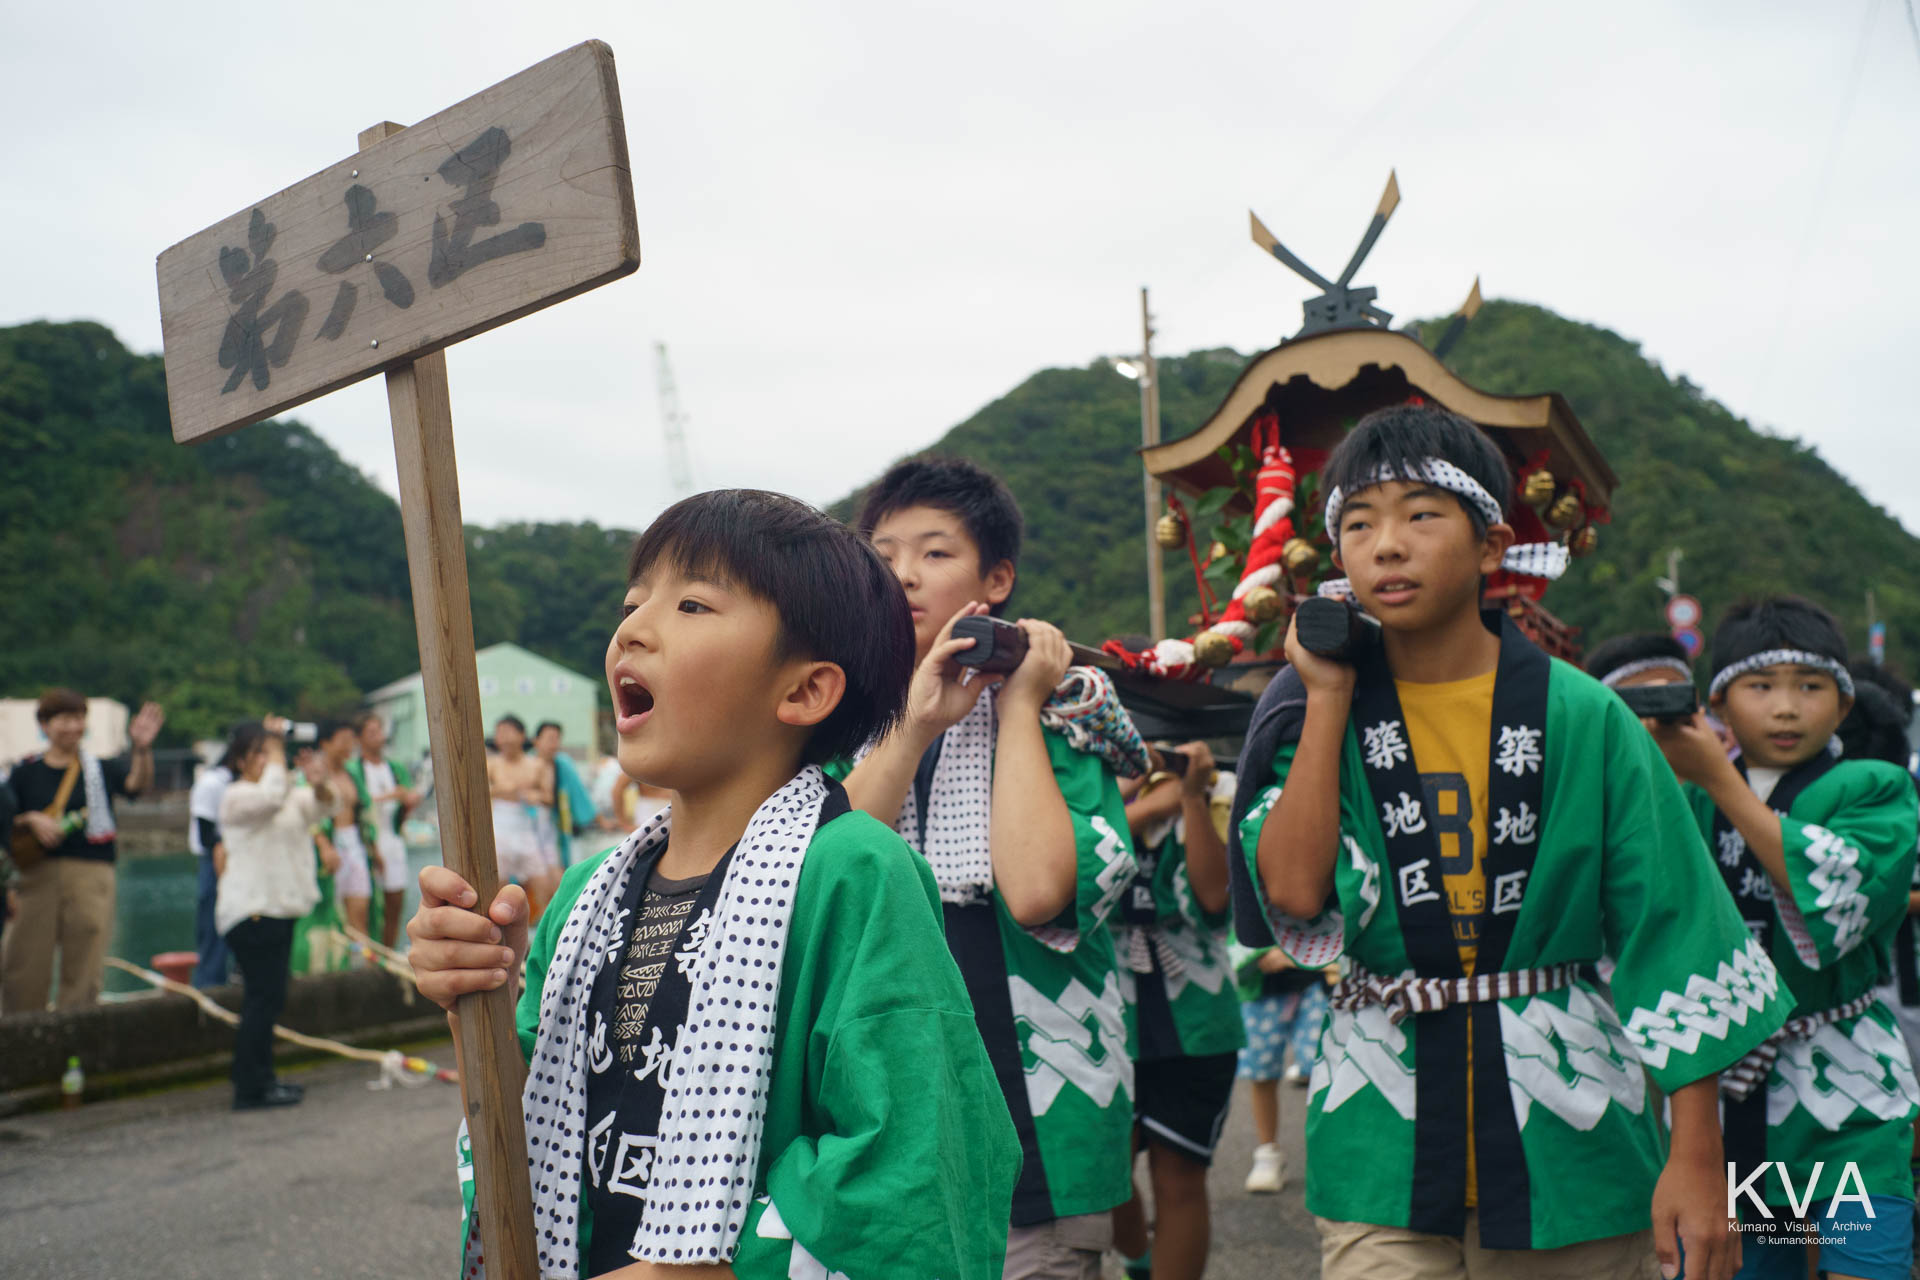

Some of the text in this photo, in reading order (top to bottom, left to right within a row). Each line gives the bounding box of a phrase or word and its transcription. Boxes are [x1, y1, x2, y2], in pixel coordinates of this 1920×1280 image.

[1362, 720, 1440, 907] 築地区
[1448, 889, 1484, 910] L'S
[1491, 724, 1543, 915] 築地区
